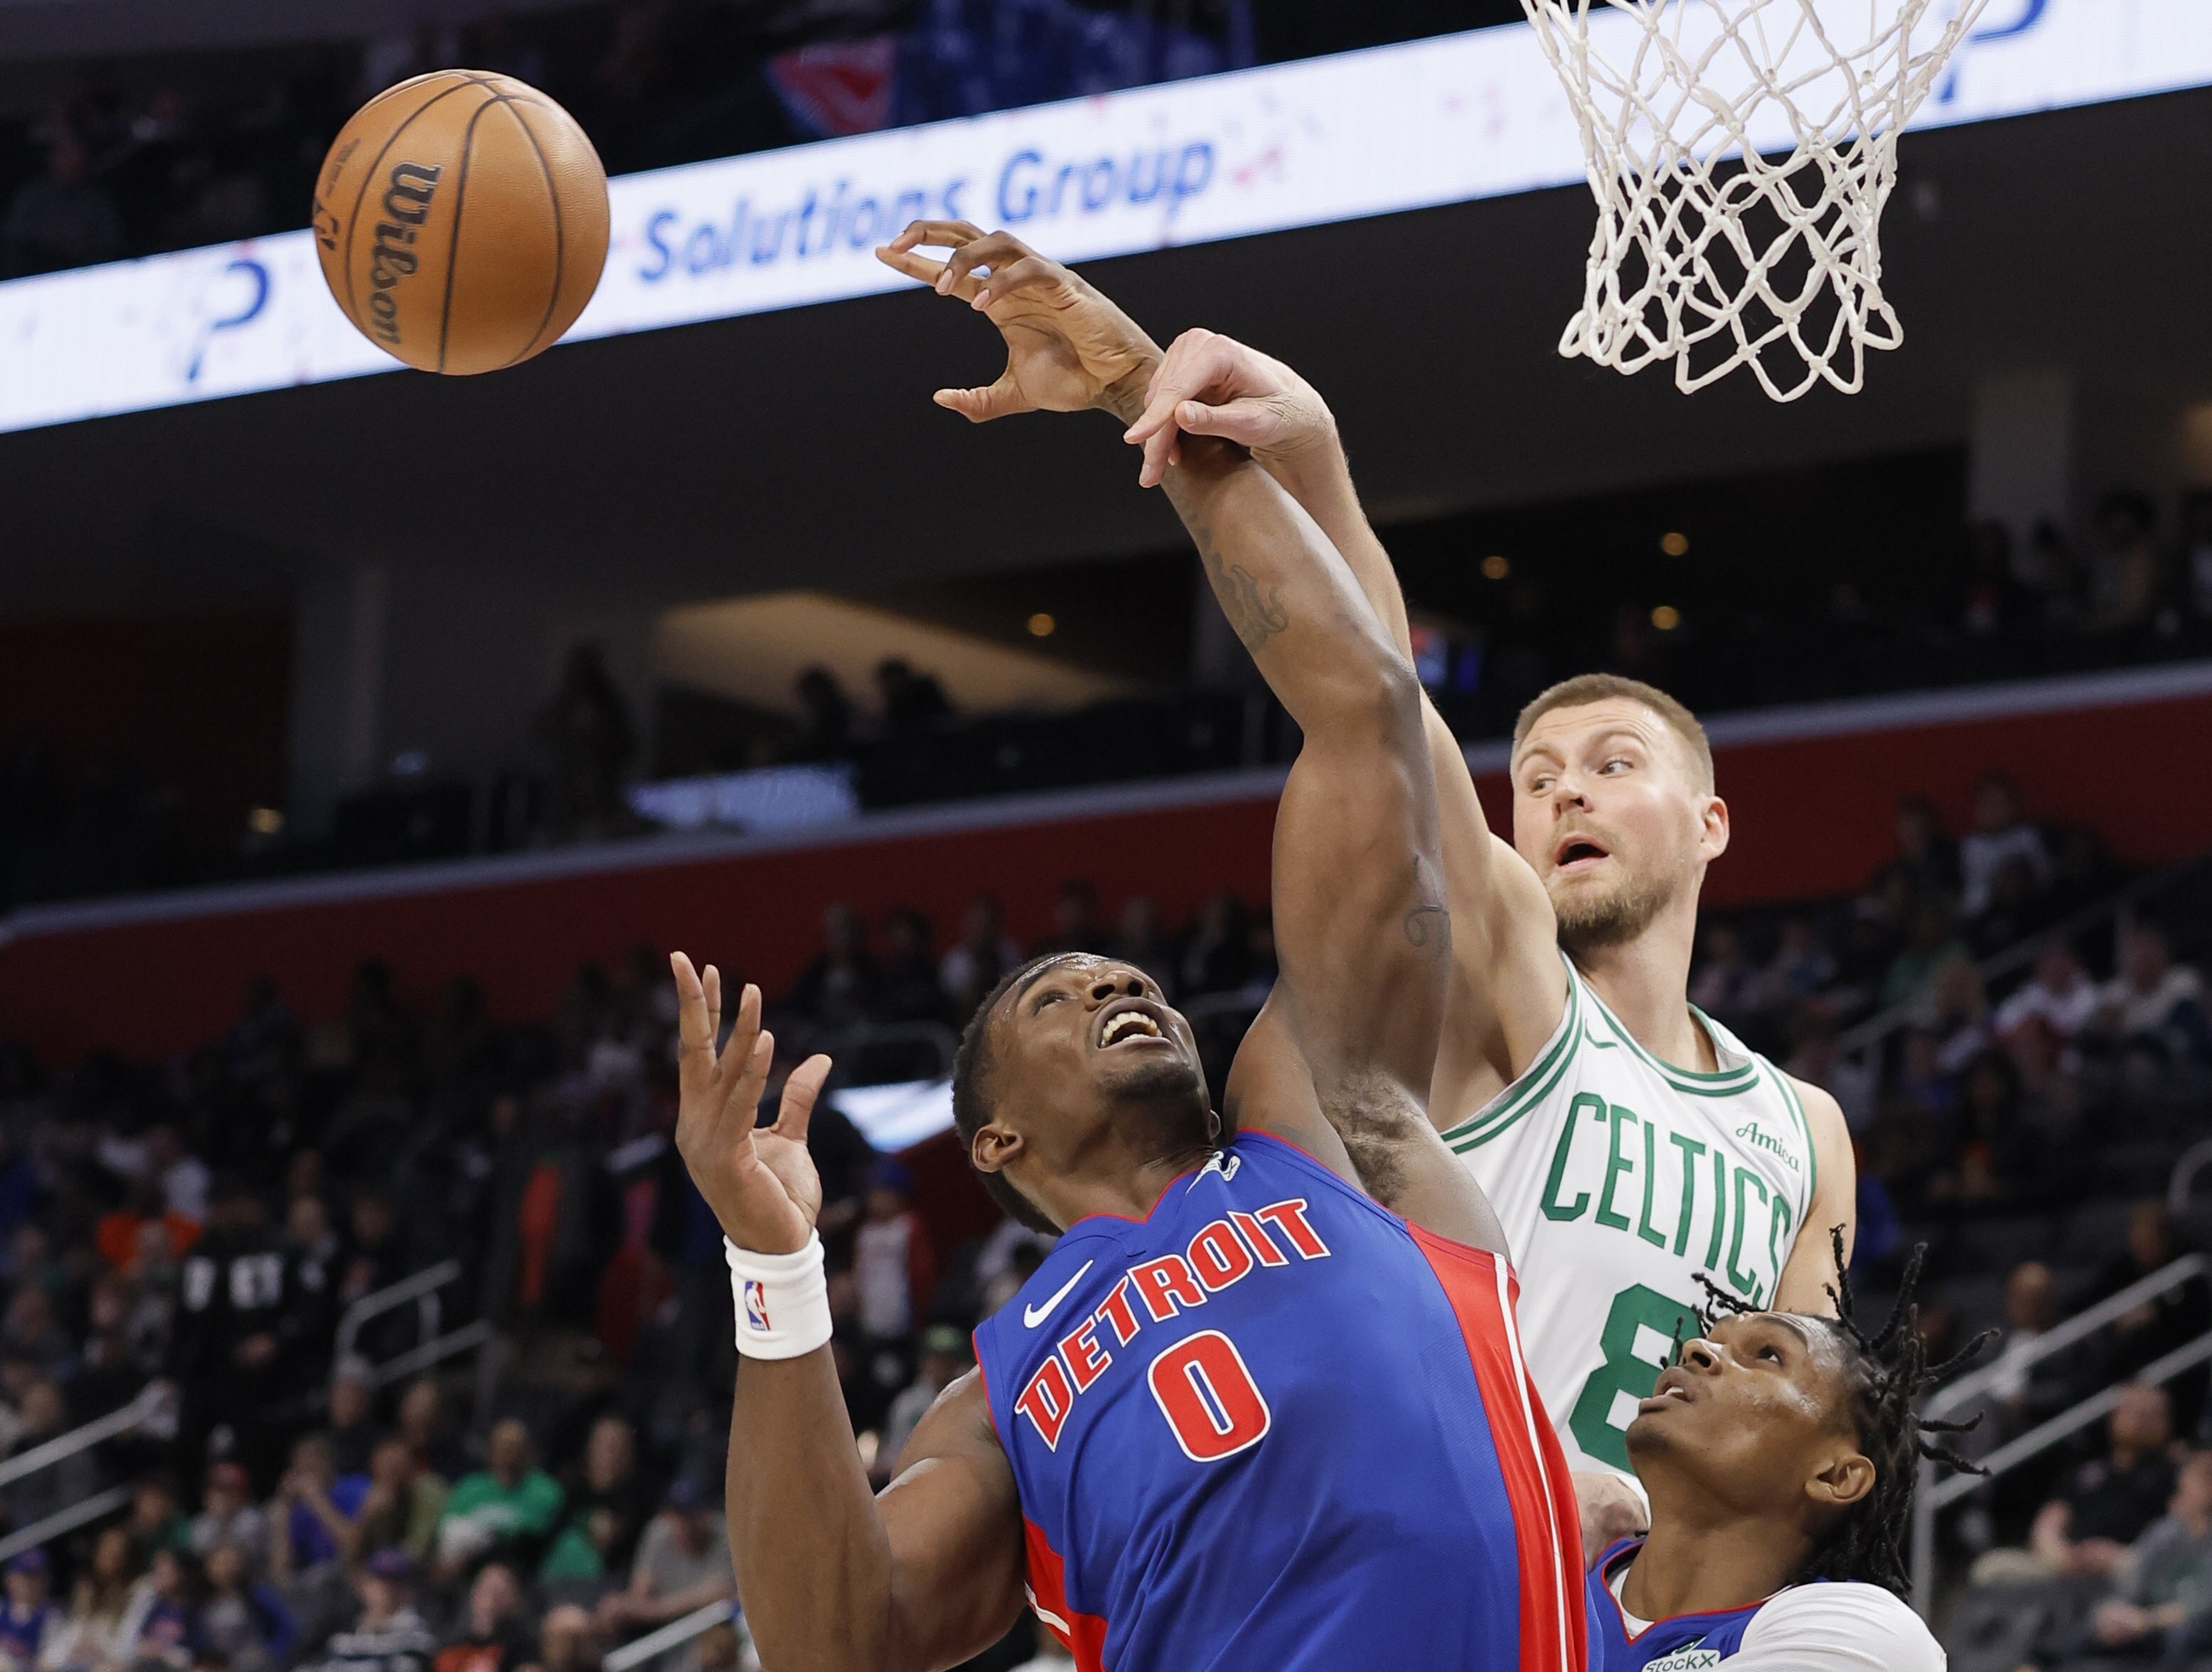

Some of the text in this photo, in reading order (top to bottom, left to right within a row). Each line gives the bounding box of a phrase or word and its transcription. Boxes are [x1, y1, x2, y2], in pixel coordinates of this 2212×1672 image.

[368, 161, 444, 345] Wilson
[638, 140, 1216, 283] Solutions Group
[1735, 1122, 1799, 1173] Amica
[1014, 1198, 1332, 1454] DETROIT
[1147, 1328, 1272, 1463] 0
